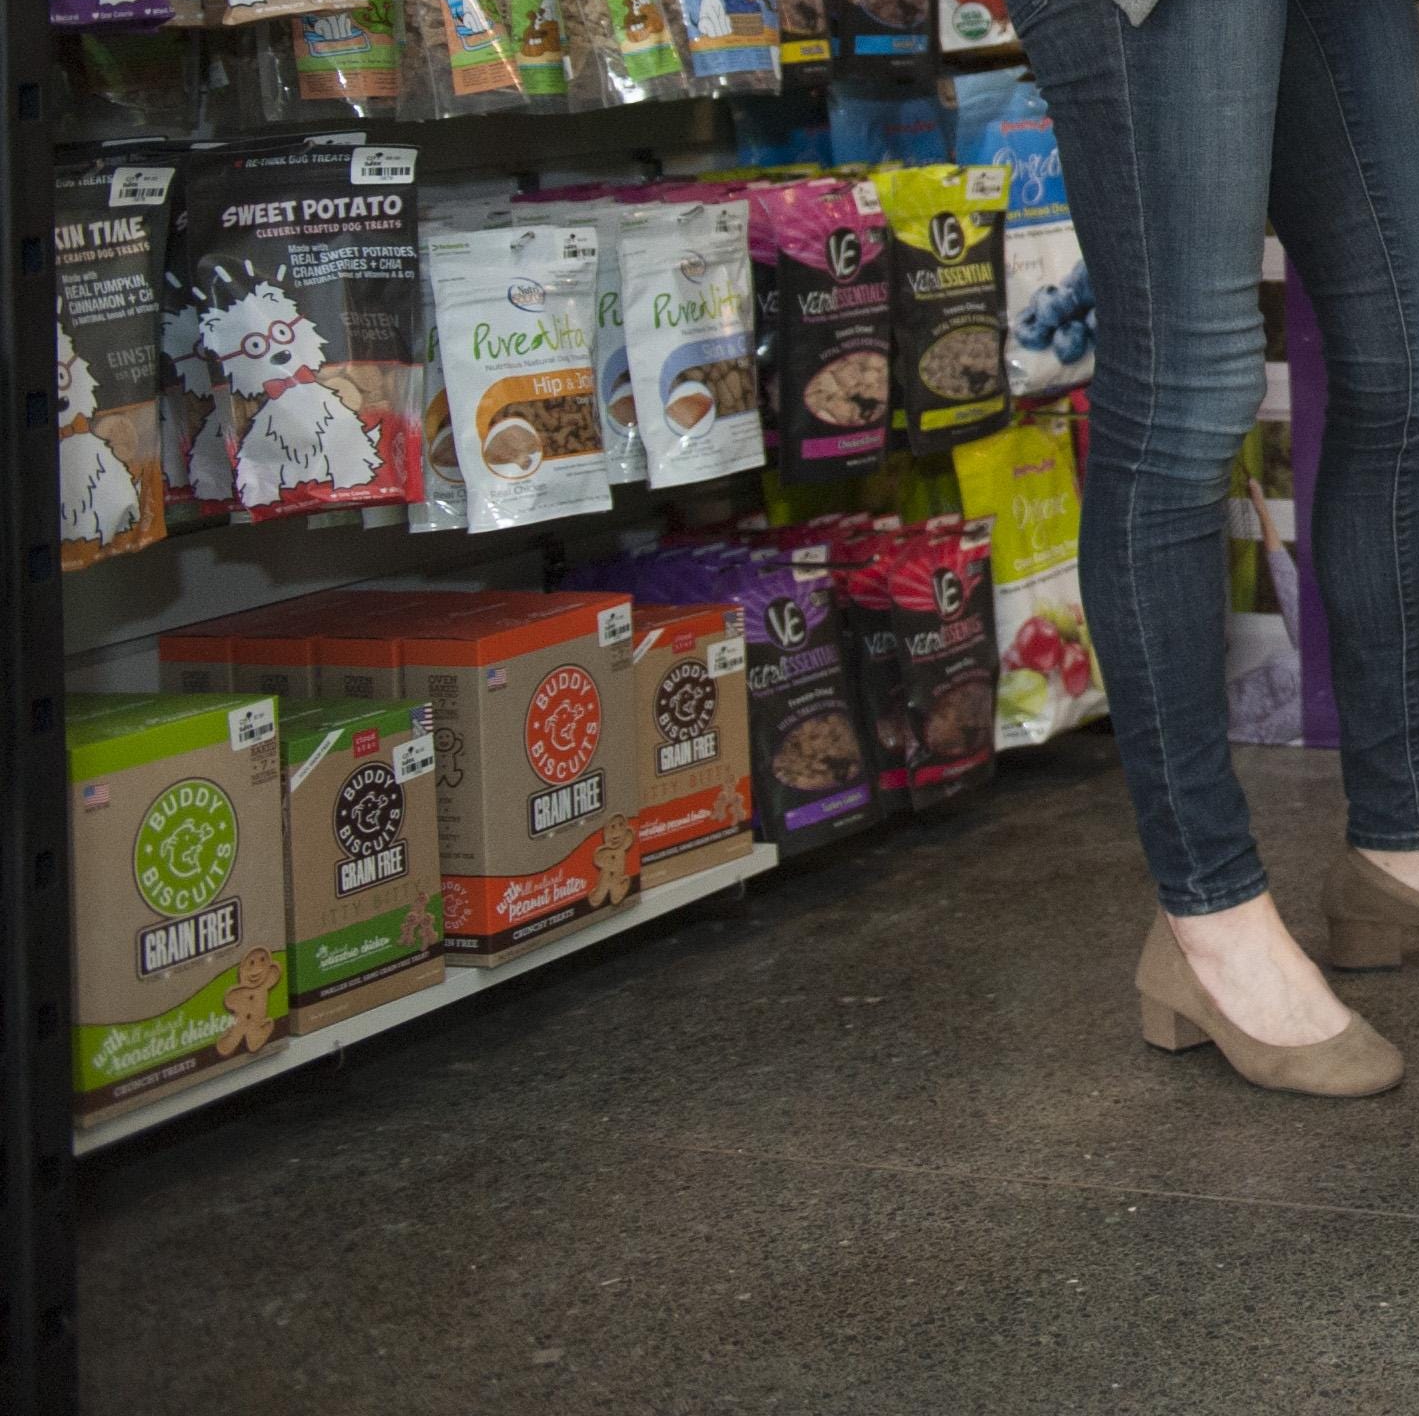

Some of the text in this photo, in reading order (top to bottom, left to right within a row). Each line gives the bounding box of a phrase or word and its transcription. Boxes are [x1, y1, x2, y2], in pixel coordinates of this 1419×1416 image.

[312, 153, 350, 164] TREATS
[90, 216, 147, 243] TIME
[222, 195, 402, 228] SWEET POTATO
[256, 225, 300, 239] CLEVERLY
[342, 222, 361, 233] DOG
[365, 220, 402, 231] TREATS
[118, 242, 150, 257] TREATS
[290, 251, 316, 266] REAL
[319, 246, 359, 262] SWEET
[830, 232, 856, 276] VE
[932, 217, 958, 258] VE
[292, 258, 402, 279] CRANBERRIES + CHIA
[65, 283, 91, 299] REAL
[69, 295, 125, 315] CINNAMON
[108, 345, 157, 367] EINST
[534, 375, 562, 396] Hip
[934, 571, 961, 615] VE
[769, 601, 804, 647] VE
[535, 672, 592, 710] BUDDY
[663, 665, 710, 692] BUDDY
[659, 699, 716, 741] BISCUITS
[530, 721, 599, 780] BISCUITS
[661, 732, 718, 772] GRAIN FREE
[344, 769, 395, 801] BUDDY
[534, 787, 572, 832] GRAIN
[575, 775, 601, 816] FREE
[150, 787, 223, 832] BUDDY
[339, 808, 401, 856] BISCUITS
[142, 842, 233, 911] BISCUITS
[341, 845, 404, 892] GRAIN FREE
[509, 892, 551, 922] peanut
[548, 908, 576, 928] TREATS
[145, 904, 236, 972] GRAIN FREE
[93, 1028, 128, 1069] with
[180, 1012, 239, 1049] chicken
[114, 1058, 197, 1098] CRUNCHY TREATS
